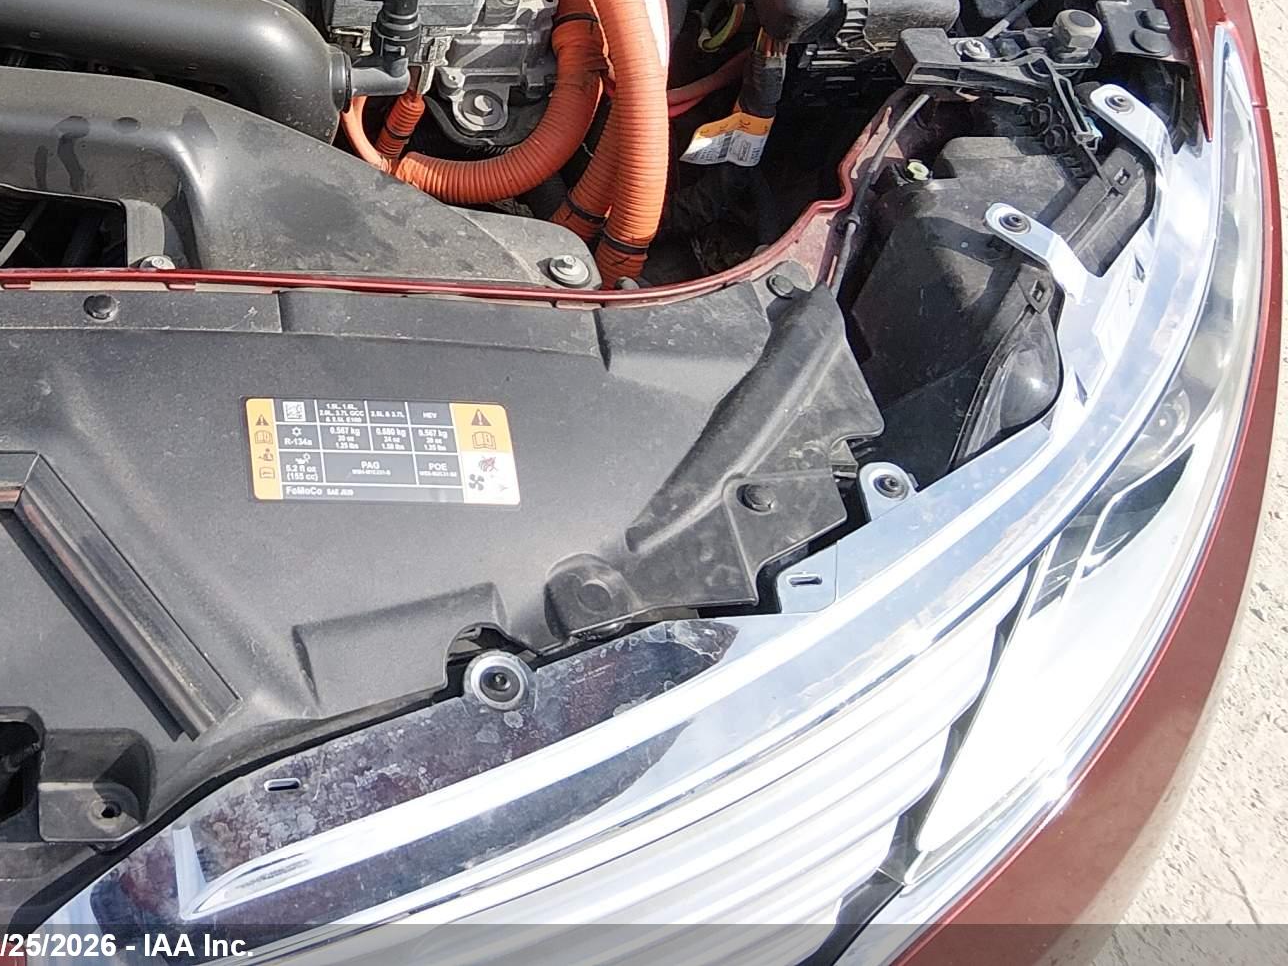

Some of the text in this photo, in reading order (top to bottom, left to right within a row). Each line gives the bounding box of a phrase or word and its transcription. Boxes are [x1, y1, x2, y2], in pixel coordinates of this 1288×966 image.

[350, 427, 360, 436] kg
[396, 428, 406, 437] kg
[438, 429, 448, 439] kg
[284, 437, 312, 446] R-134a
[361, 460, 380, 469] PAG
[428, 462, 447, 471] POE
[305, 473, 318, 481] cc)
[286, 486, 322, 495] FoMoCo
